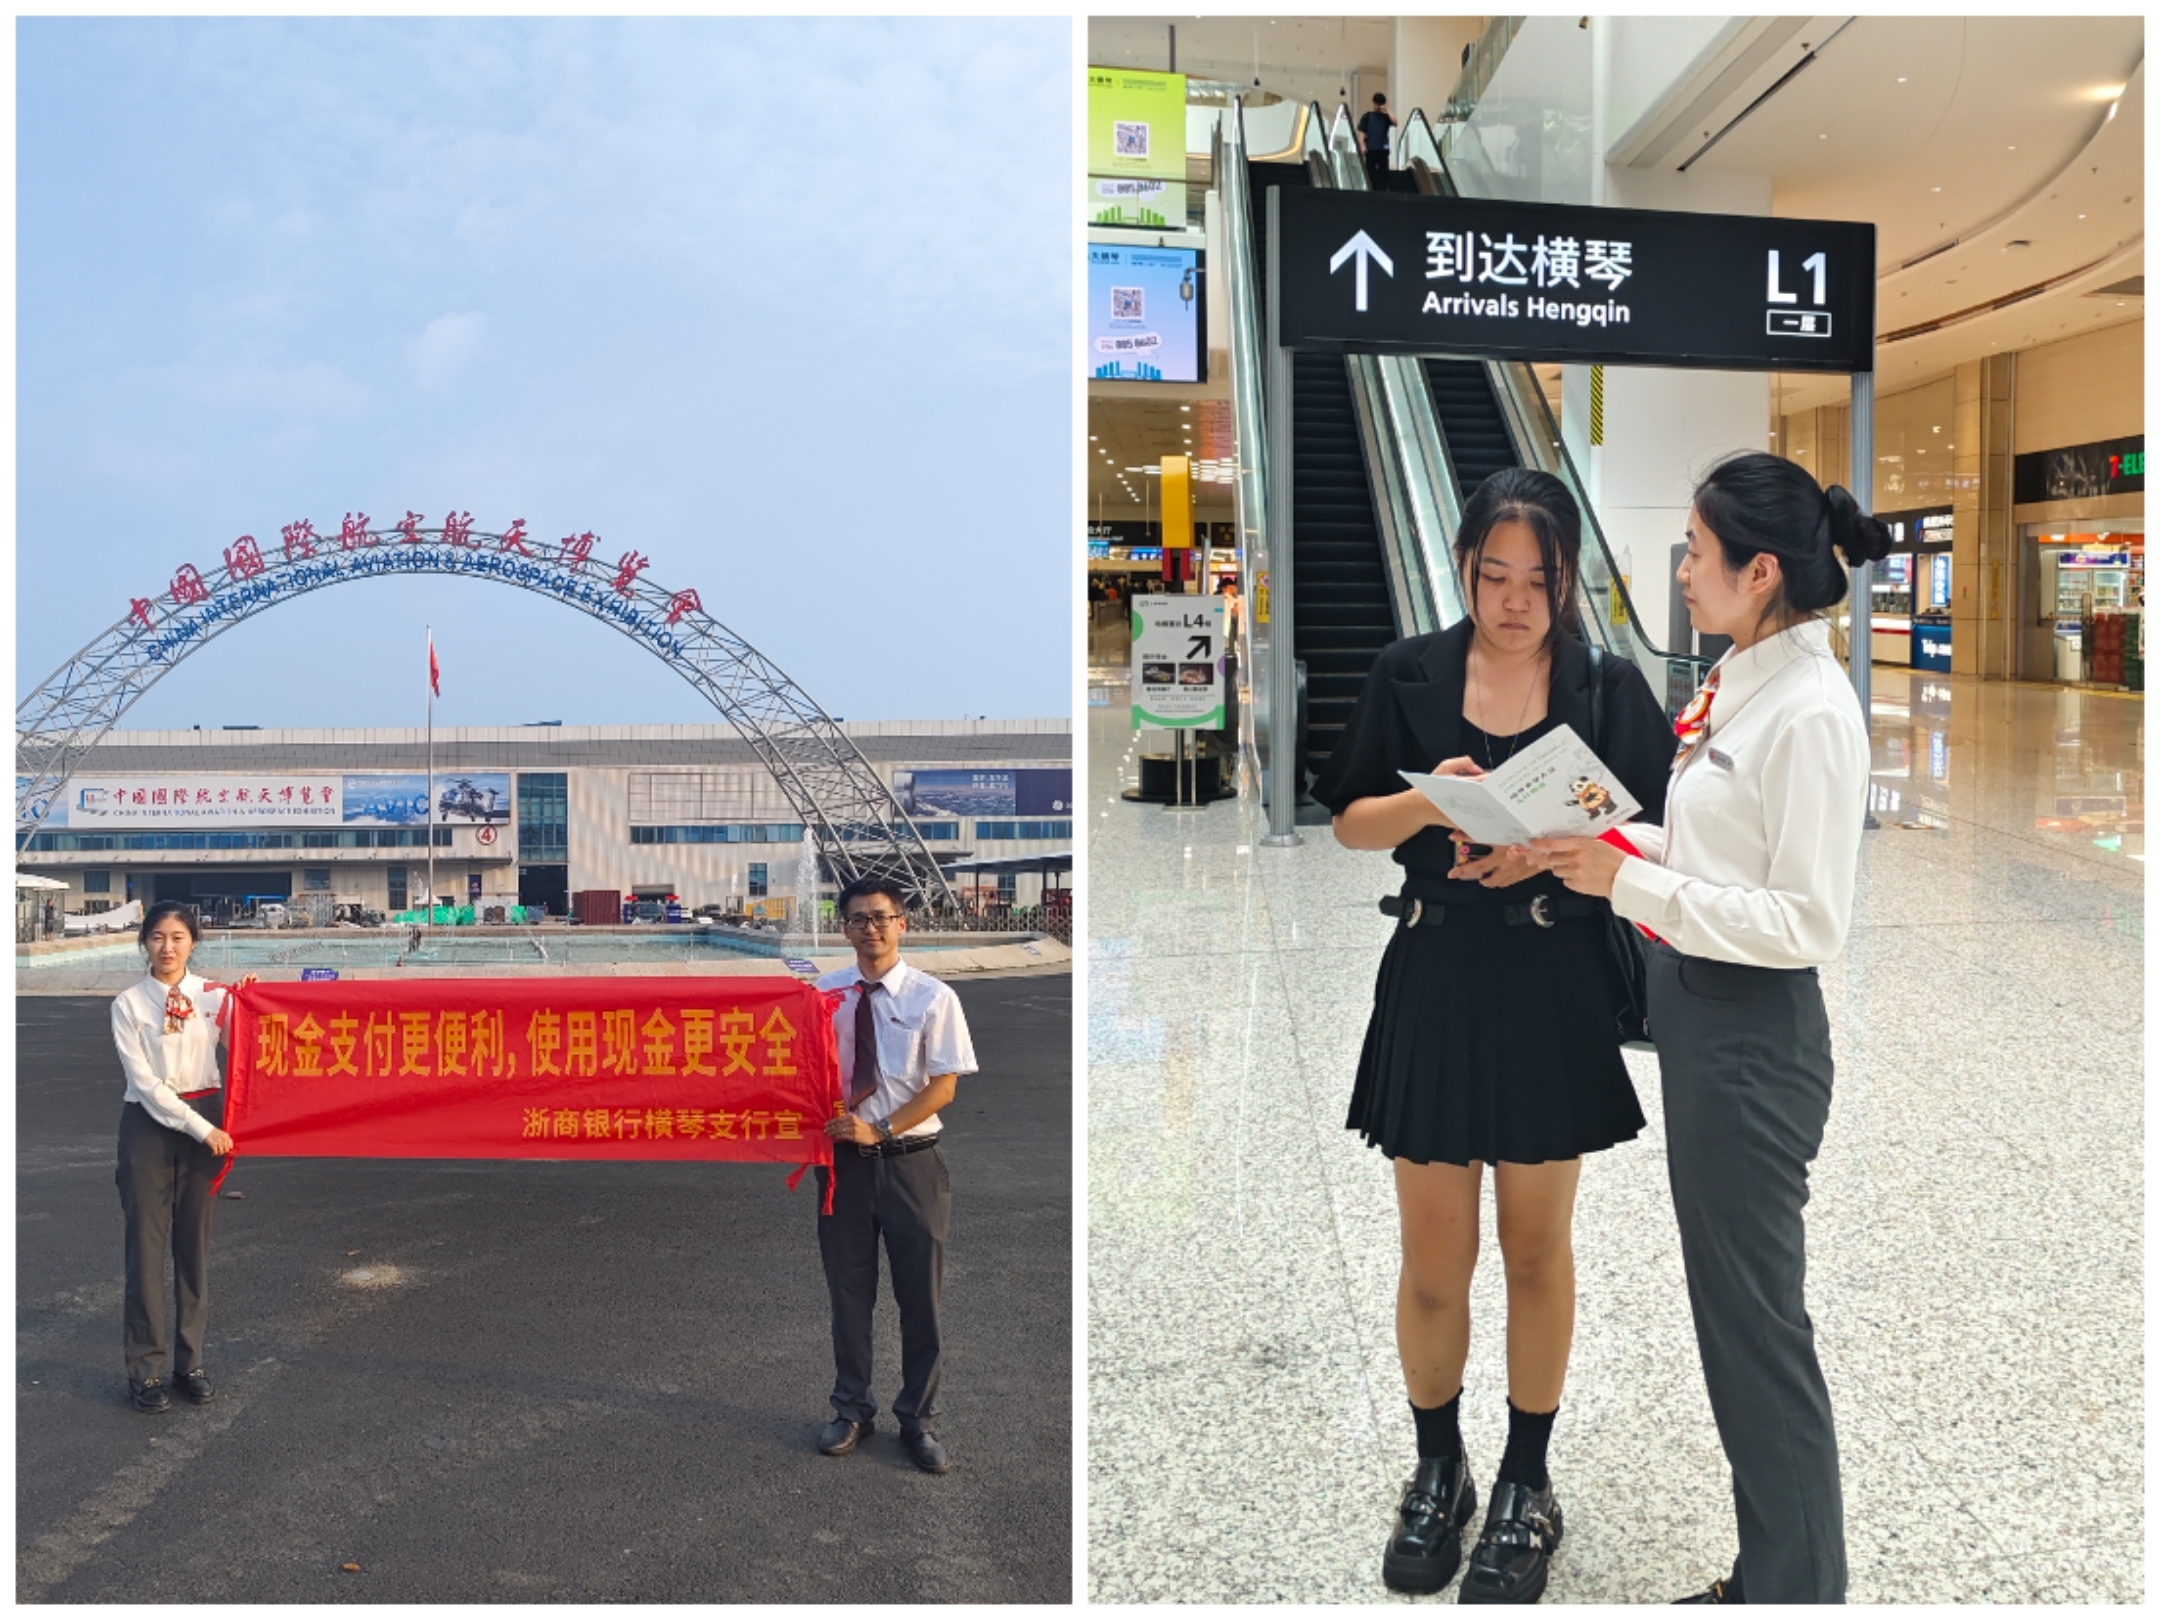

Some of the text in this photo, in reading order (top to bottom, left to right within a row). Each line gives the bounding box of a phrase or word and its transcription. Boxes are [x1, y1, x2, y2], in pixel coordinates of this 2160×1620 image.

[1424, 230, 1633, 292] 到达横琴
[1767, 249, 1827, 305] L1
[1422, 291, 1631, 327] Arrivals Hengqin
[1783, 315, 1816, 332] 一层
[147, 551, 686, 661] CHINA INTERNATIONAL AVIATION & AEROSPACE EXHIBITION
[1183, 613, 1204, 628] L4
[363, 794, 430, 816] AVIC
[256, 1006, 798, 1079] 现金支付更便利，使用现金更安全
[522, 1107, 804, 1140] 浙商银行横琴支行宣
